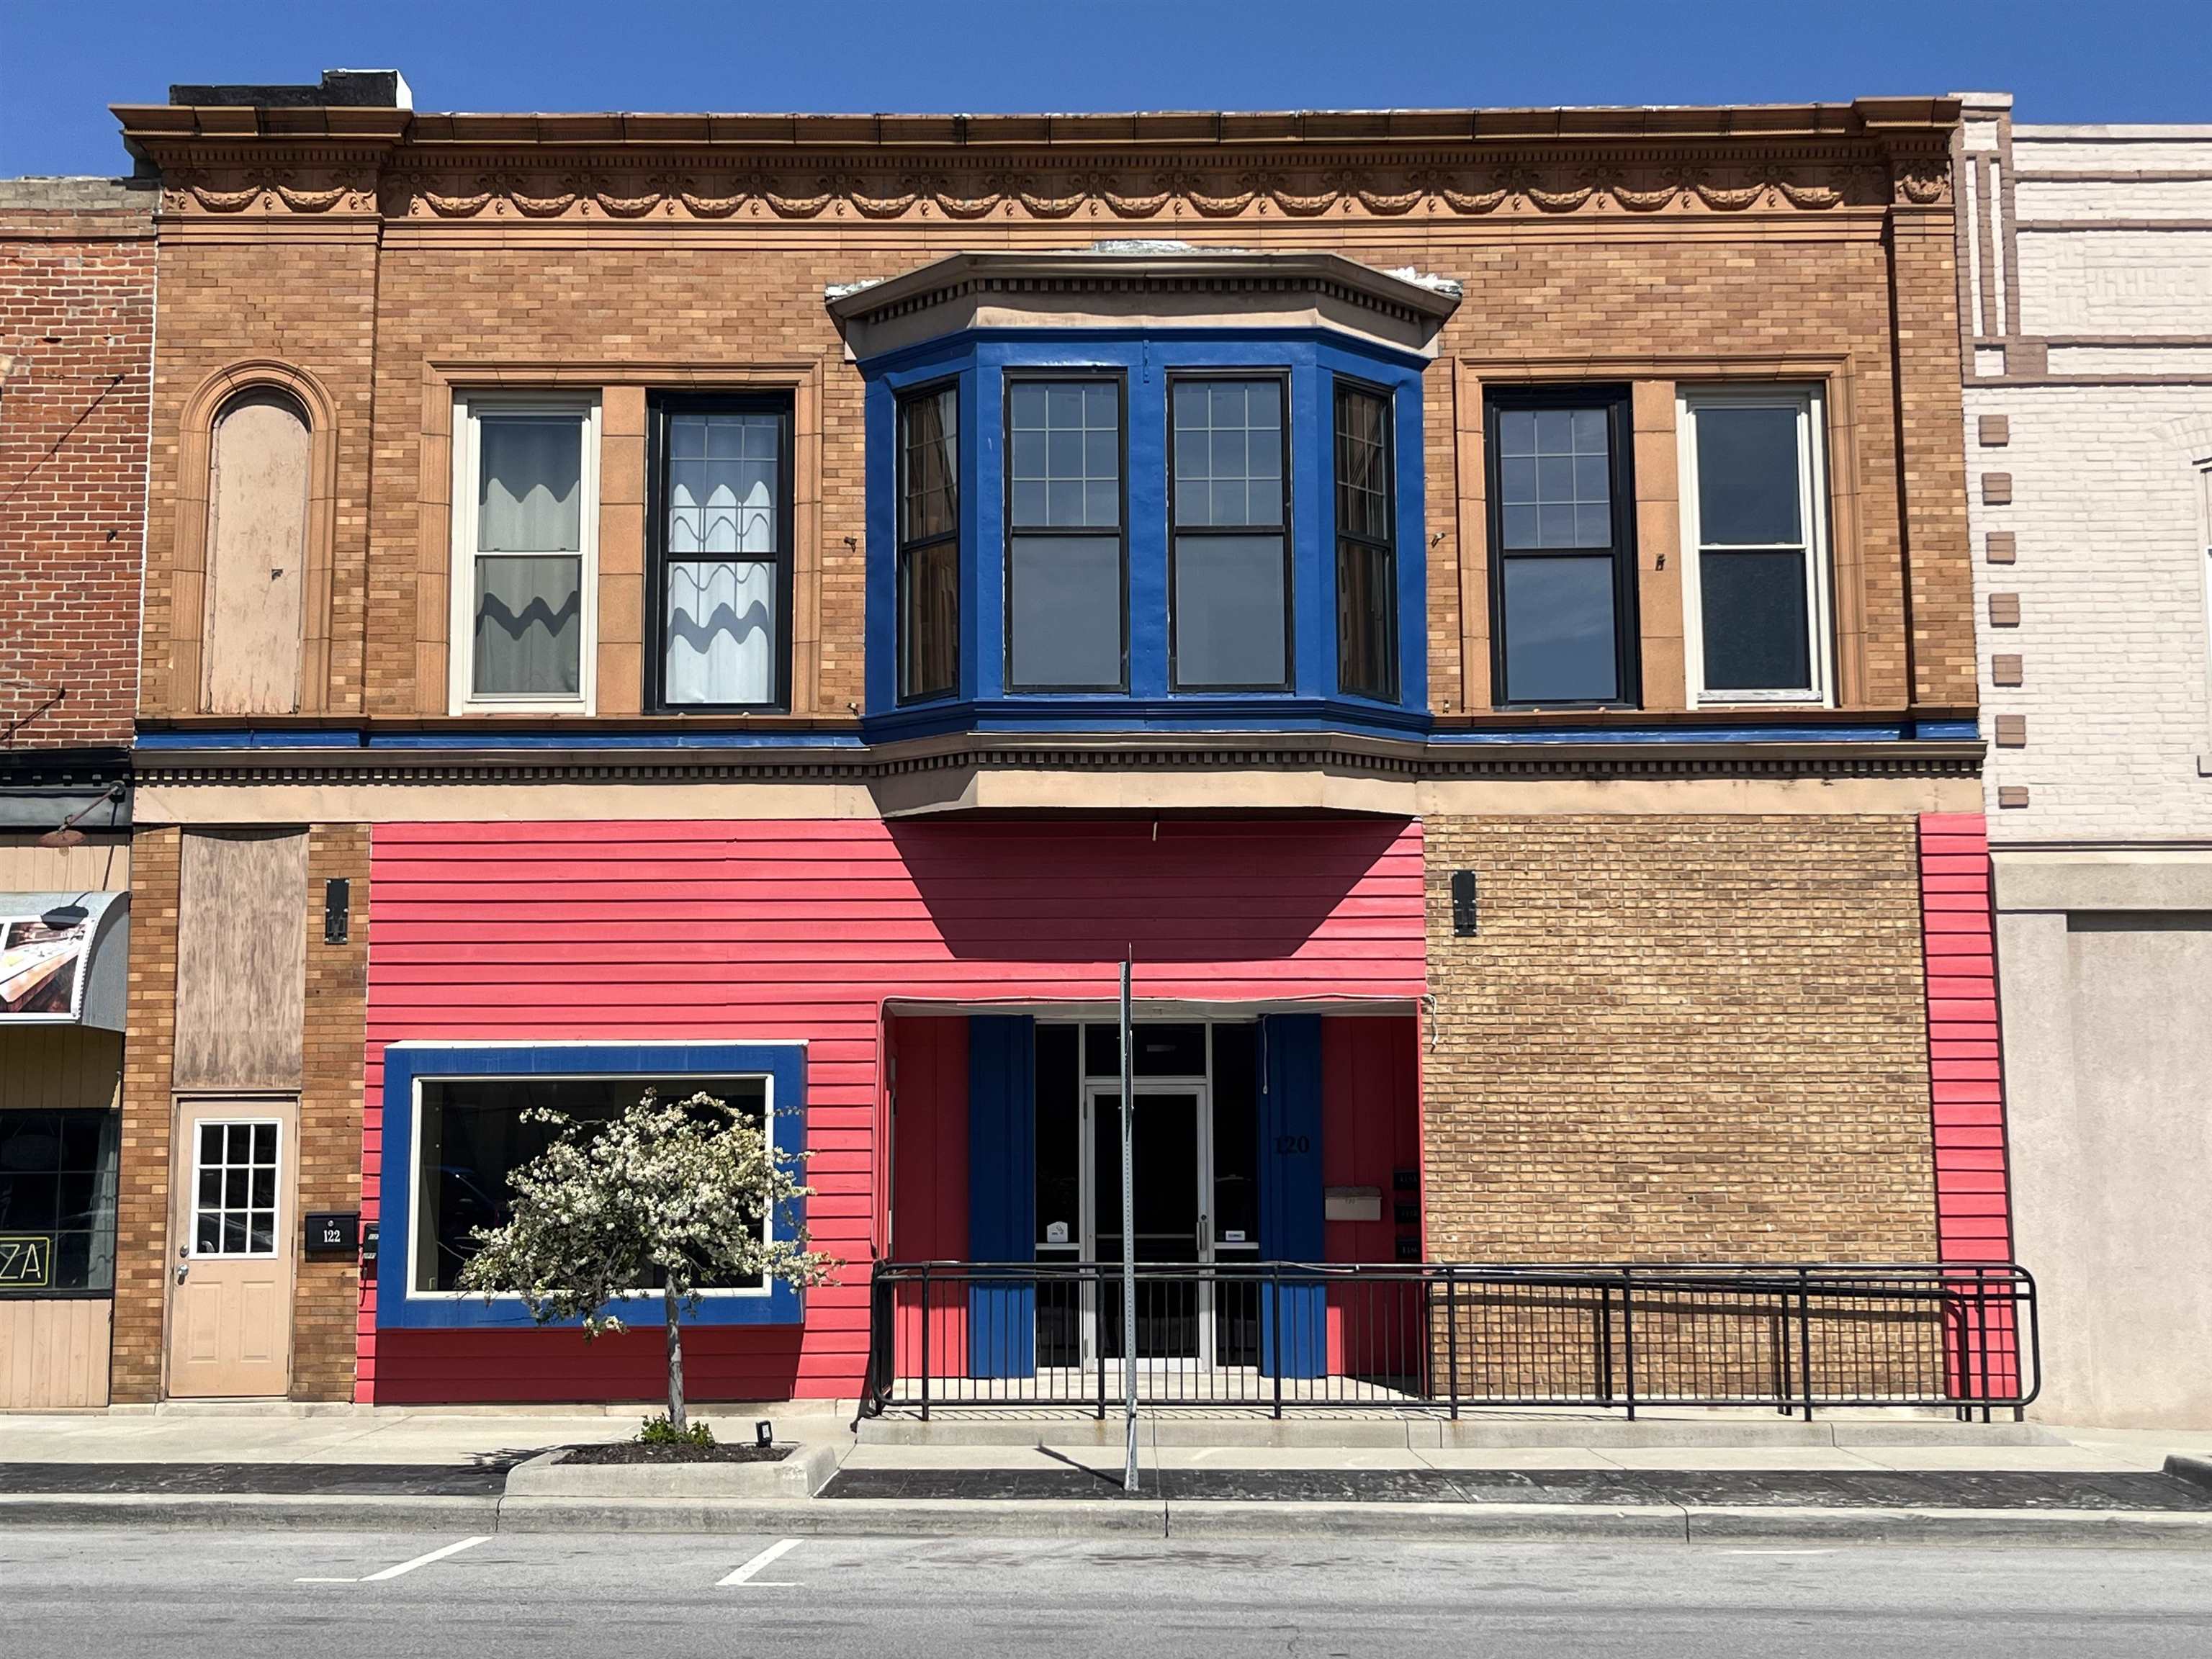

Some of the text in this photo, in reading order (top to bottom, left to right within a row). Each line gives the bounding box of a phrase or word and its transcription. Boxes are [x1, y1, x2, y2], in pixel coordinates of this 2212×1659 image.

[1274, 1135, 1310, 1154] 120
[323, 1229, 341, 1243] 122
[0, 1244, 41, 1279] ZA
